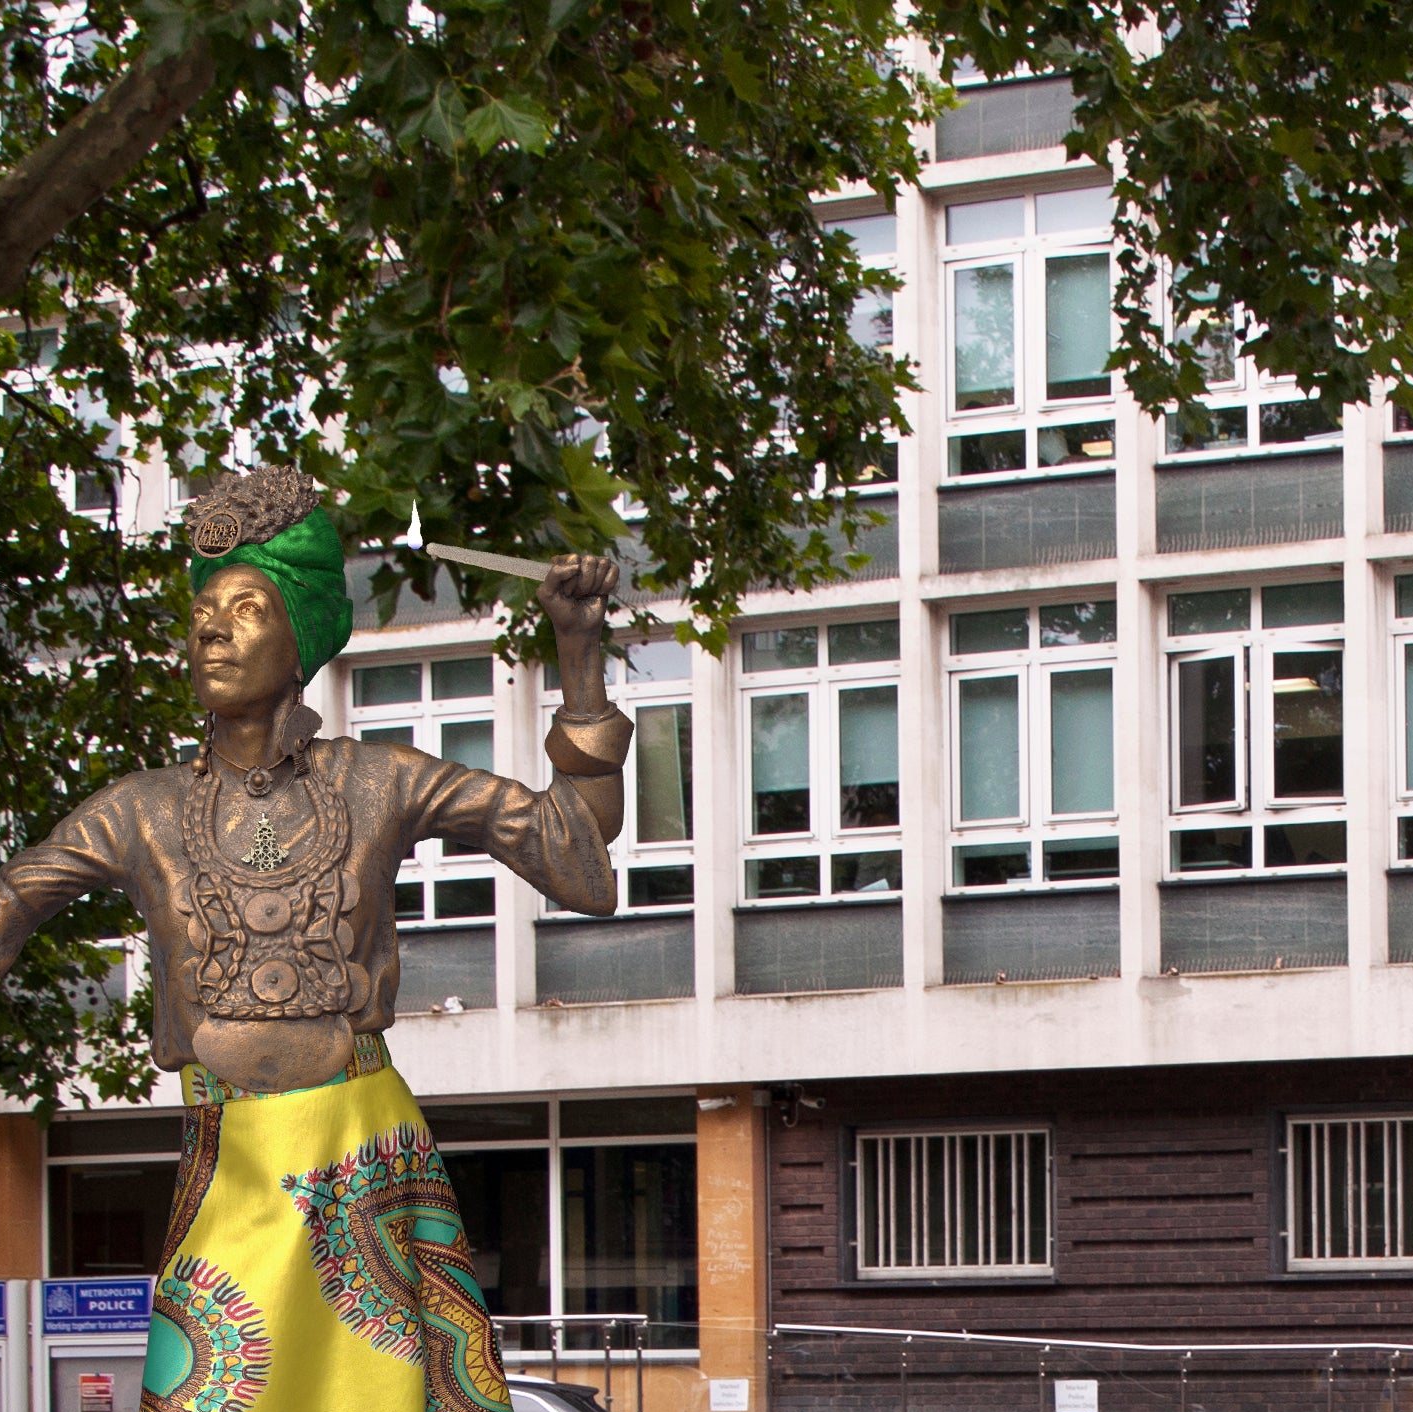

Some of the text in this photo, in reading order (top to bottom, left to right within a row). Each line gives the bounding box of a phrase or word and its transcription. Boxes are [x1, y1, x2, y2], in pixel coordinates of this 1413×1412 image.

[80, 1288, 144, 1297] METROPOLITAN
[89, 1301, 135, 1311] POLICE
[45, 1322, 71, 1332] Working
